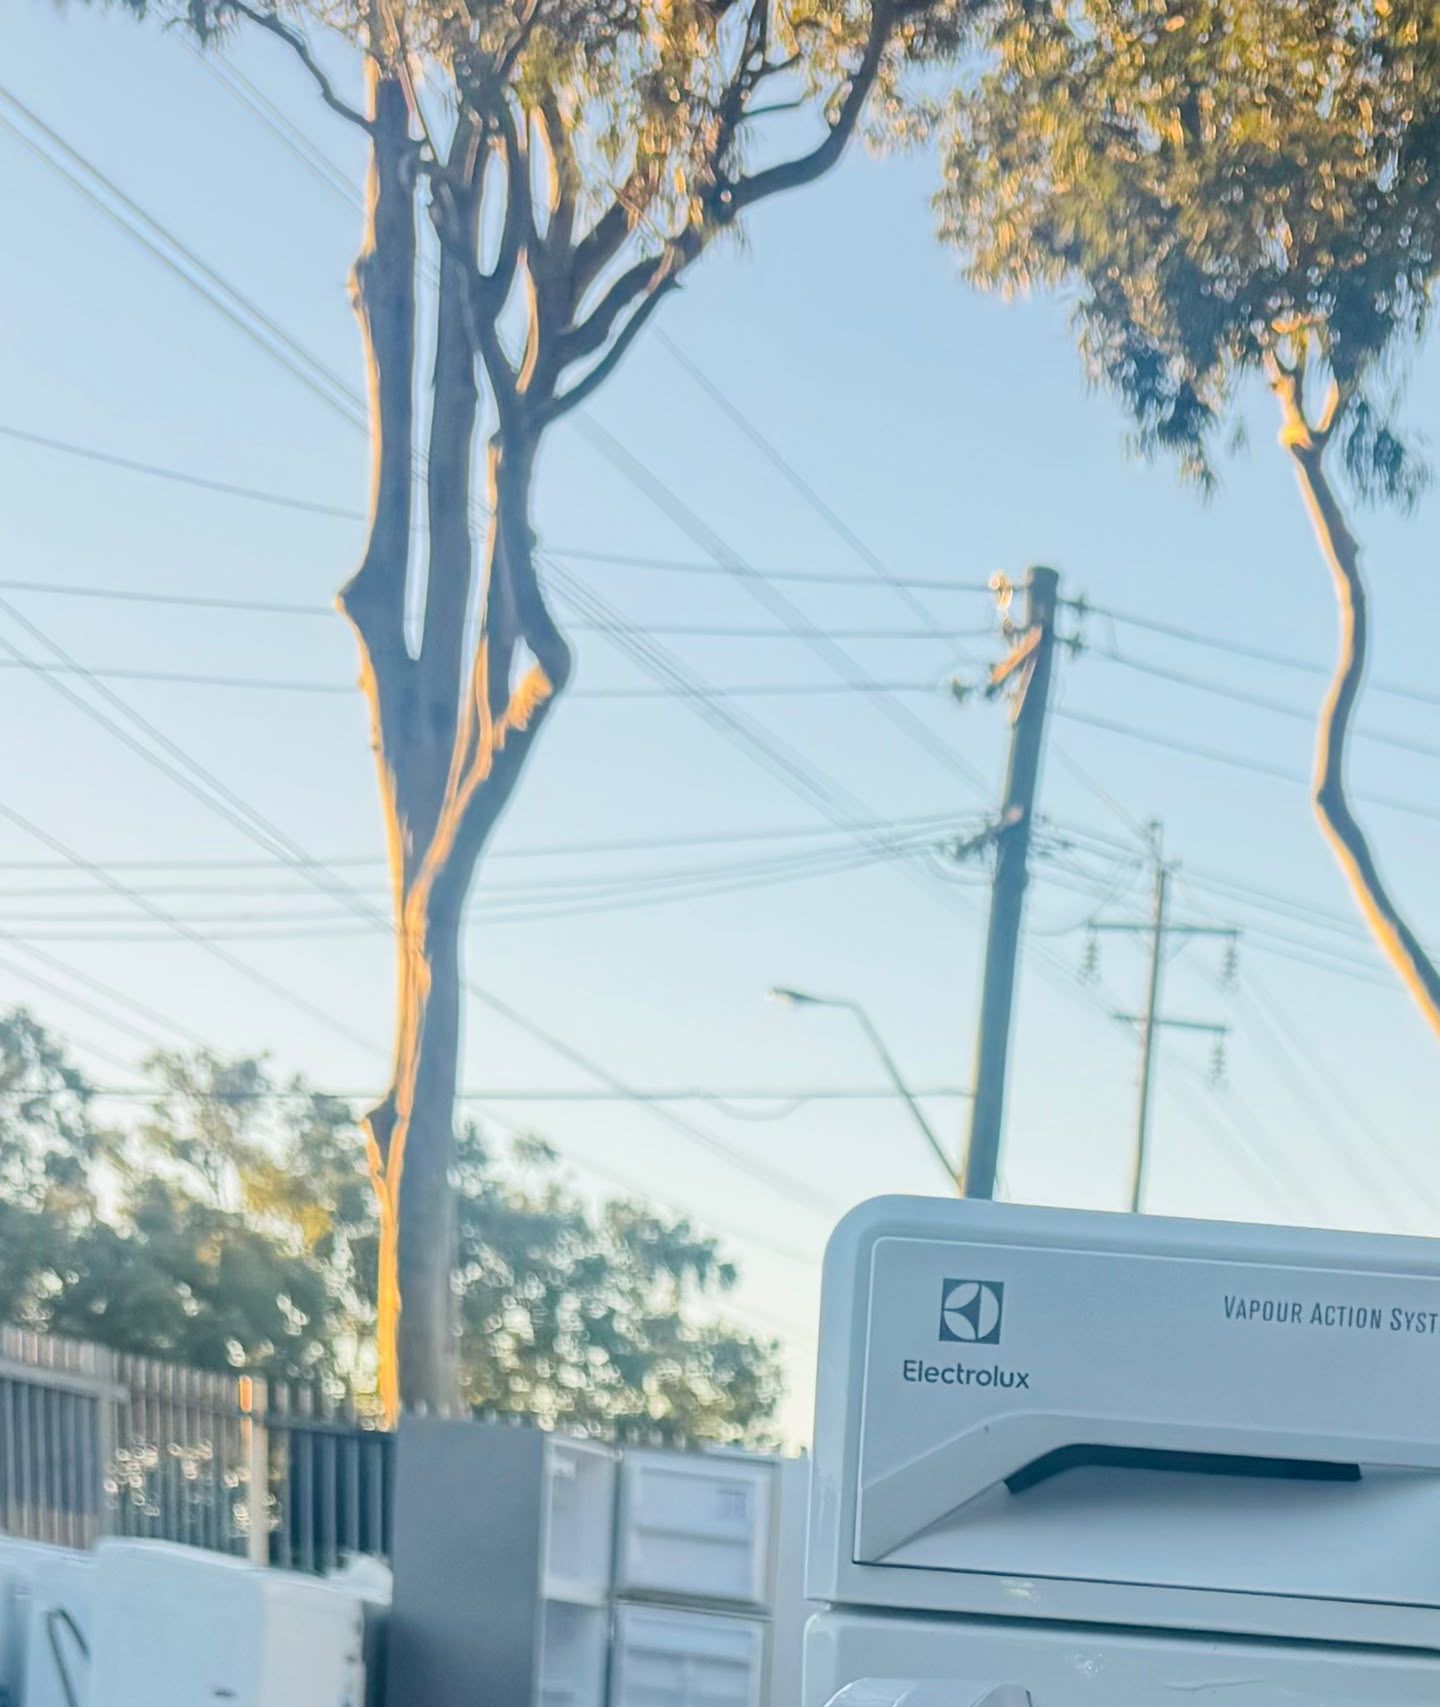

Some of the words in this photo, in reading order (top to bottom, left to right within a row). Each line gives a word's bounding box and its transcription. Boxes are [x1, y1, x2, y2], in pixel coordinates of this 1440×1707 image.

[1224, 1295, 1303, 1325] VAPOUR
[1310, 1301, 1383, 1330] ACTION
[903, 1359, 1030, 1389] Electrolux
